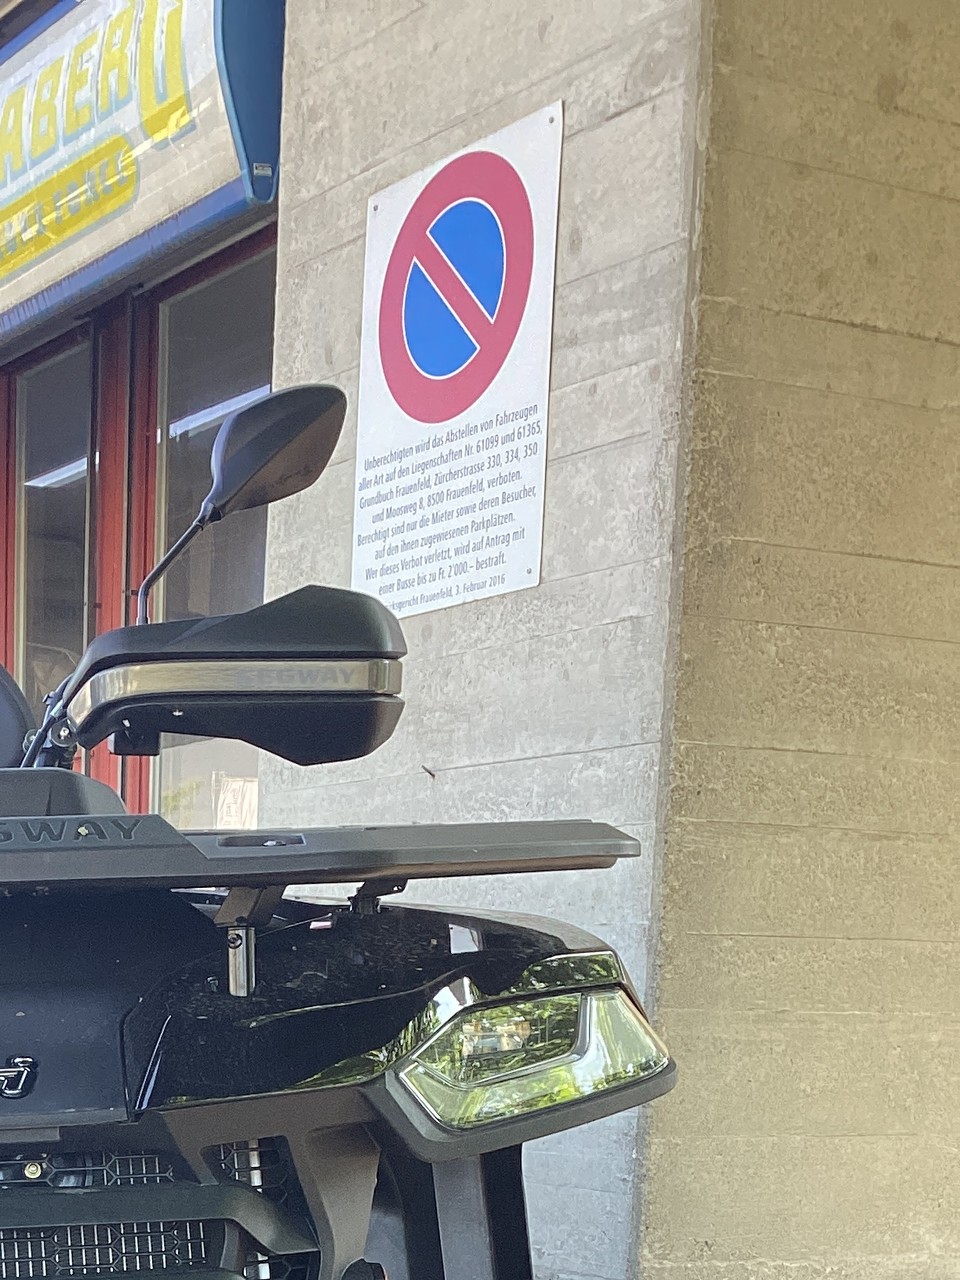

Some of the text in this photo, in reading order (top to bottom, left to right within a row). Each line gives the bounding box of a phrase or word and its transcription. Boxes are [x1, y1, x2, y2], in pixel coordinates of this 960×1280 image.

[358, 420, 543, 491] aller Art auf den Liegenschaften Nr. 61099 und 61365,
[364, 404, 538, 471] Unberechtigten wird das Abstellen von Fahrzeugen
[359, 441, 538, 509] Grundbuch Frauenfeld, Zürcherstrasse 330, 334, 350
[371, 470, 522, 524] und Moosweg 8, 8500 Frauenfeld, verboten.
[357, 484, 536, 547] Berechtigt sind nur die Mieter sowie deren Besucher,
[374, 512, 515, 560] auf den ihnen zugewiesenen Parkplätzen.
[365, 527, 526, 580] Wer dieses Verbot verletzt, wird auf Antrag mit
[378, 582, 395, 595] einer
[396, 577, 416, 591] Busse
[417, 572, 427, 586] bis
[428, 571, 436, 584] zu
[475, 551, 507, 571] bestraft.
[463, 579, 487, 594] Februar
[488, 573, 506, 588] 2016
